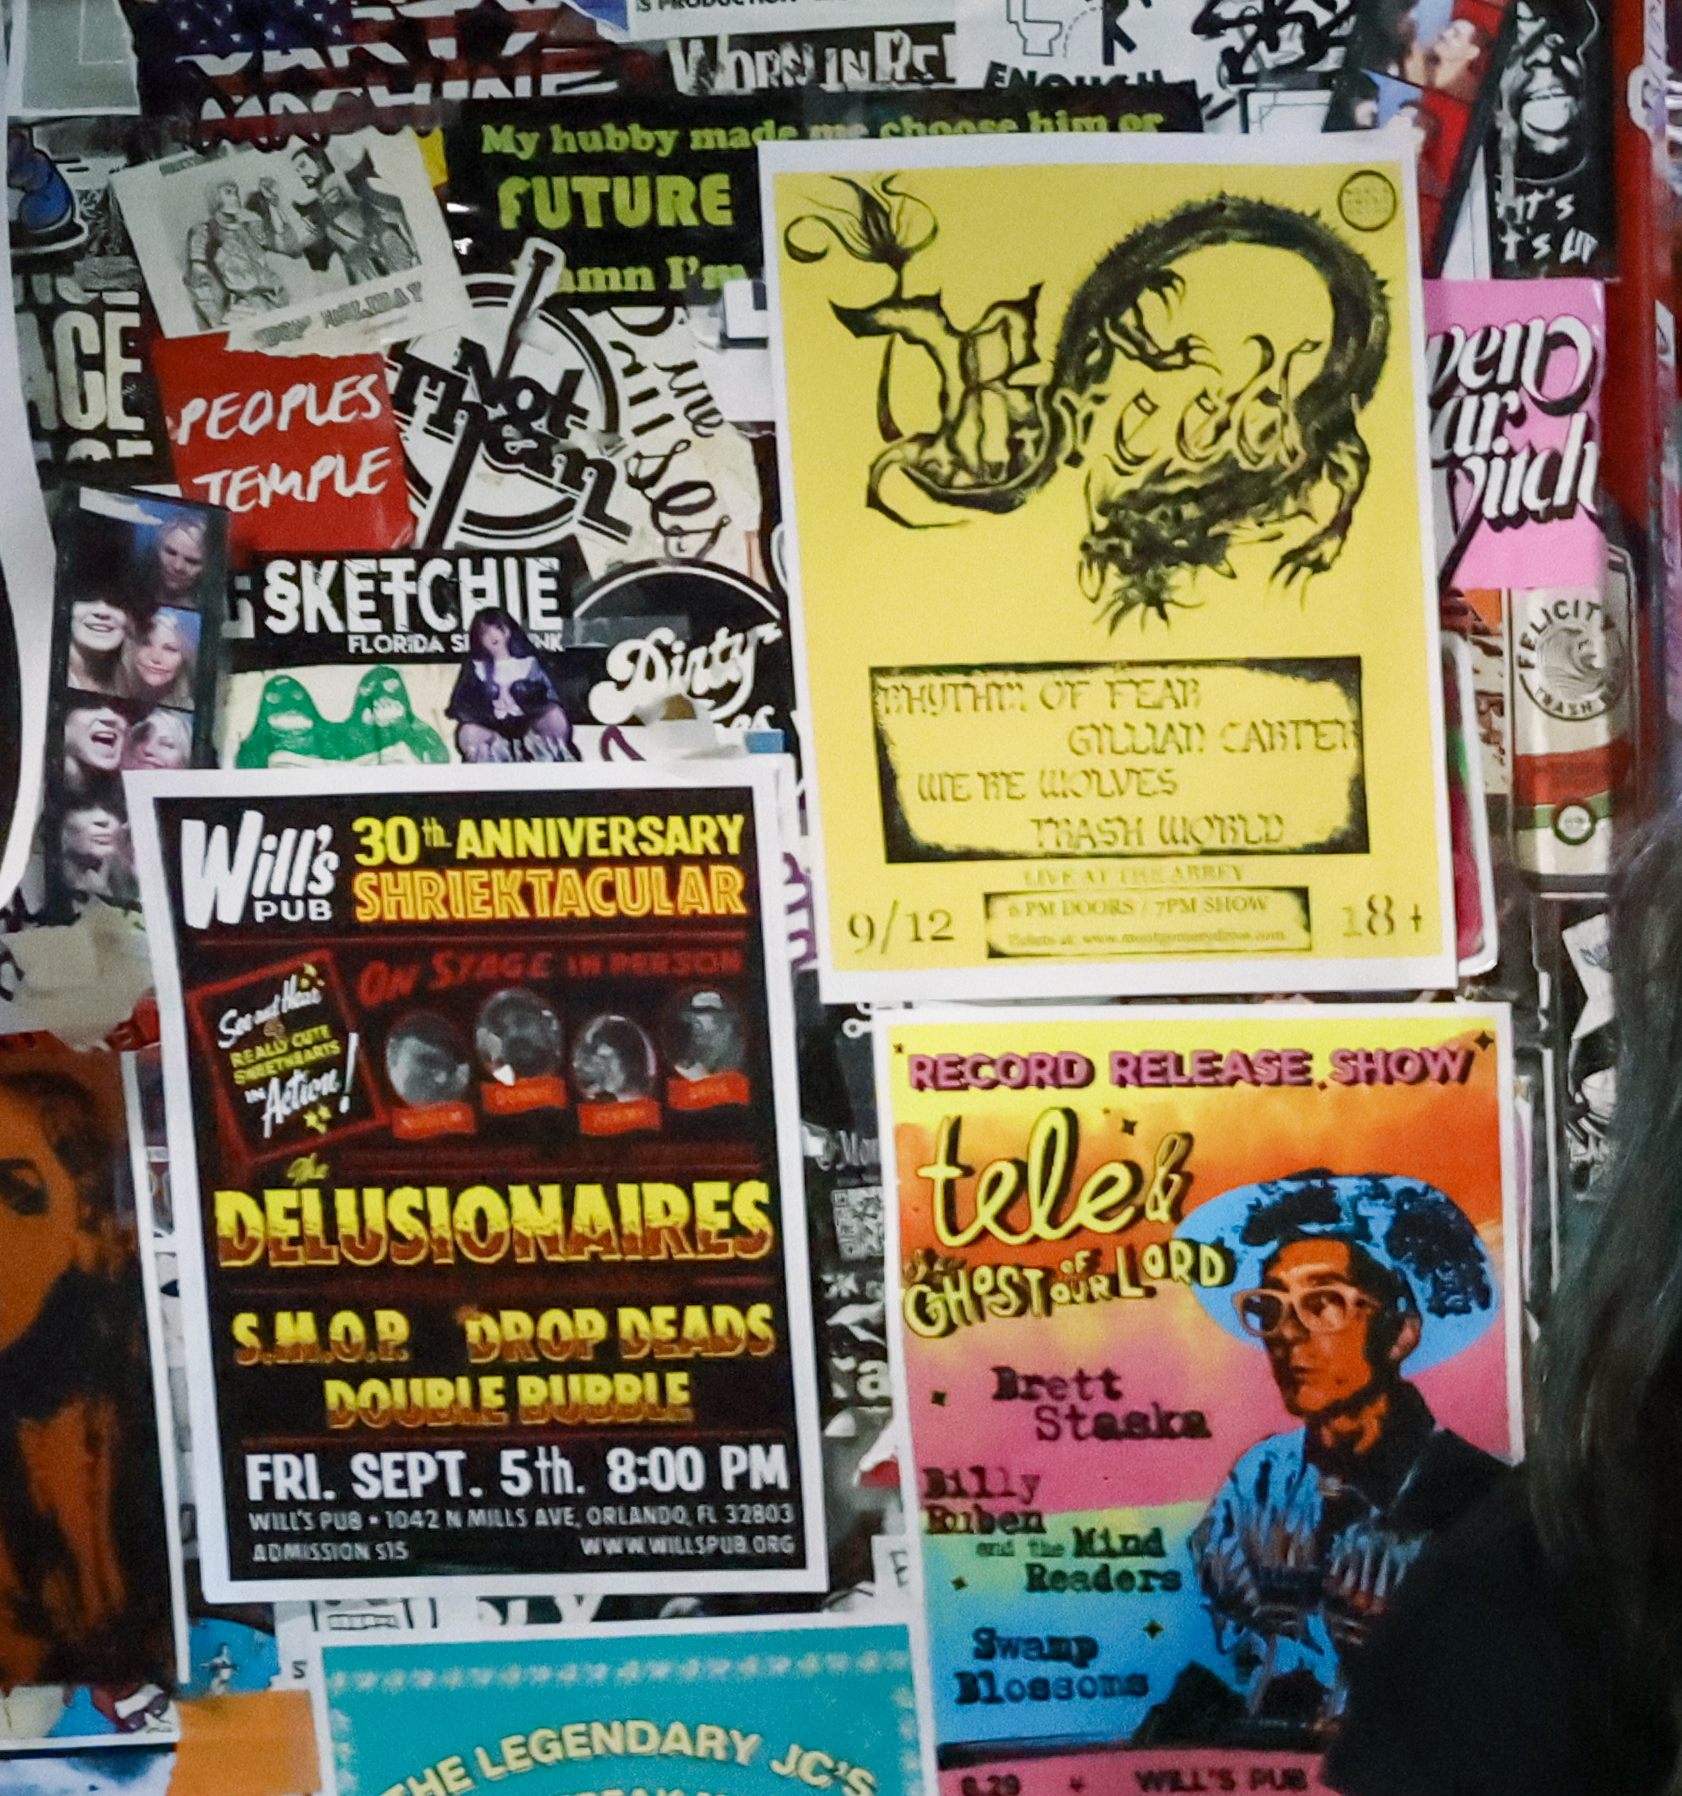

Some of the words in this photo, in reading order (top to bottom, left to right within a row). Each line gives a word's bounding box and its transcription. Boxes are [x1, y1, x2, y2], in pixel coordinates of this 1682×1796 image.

[481, 124, 541, 161] My
[552, 123, 680, 158] hubby
[689, 119, 798, 151] made
[498, 172, 733, 229] FUTURE
[174, 372, 384, 445] PEOPLES
[193, 447, 393, 513] TEMPLE
[264, 557, 564, 637] SKETCHIE
[347, 633, 442, 655] FLORIDA
[1039, 679, 1091, 711] OF
[456, 813, 745, 860] ANNIVERSARY
[1030, 816, 1144, 850] TRASH
[179, 808, 340, 930] Will's
[254, 899, 333, 922] PUB
[352, 864, 748, 924] SHRIEKTACULAR
[1062, 899, 1135, 917] DOORS
[1204, 894, 1269, 914] SHOW
[848, 900, 955, 954] 9/12
[907, 1050, 1098, 1092] RECORD
[1107, 1047, 1315, 1088] RELEASE
[1327, 1046, 1476, 1085] SHOW
[213, 1180, 776, 1268] DELUSIONAIRES
[1115, 1235, 1236, 1301] LORD
[463, 1307, 607, 1365] DROP
[616, 1303, 778, 1360] DEADS
[324, 1375, 511, 1431] DOUBLE
[518, 1370, 696, 1426] BUBBLE
[990, 1363, 1125, 1404] Brett
[244, 1451, 338, 1502] FRI.
[350, 1449, 485, 1501] SEPT.
[606, 1445, 705, 1492] 8:00
[720, 1443, 791, 1491] PM
[921, 1465, 1042, 1506] Billy
[249, 1509, 314, 1532] WILL'S
[319, 1509, 363, 1531] PUB
[385, 1507, 441, 1530] 1042
[446, 1508, 463, 1528] N
[467, 1507, 527, 1528] MILLS
[724, 1502, 796, 1526] 32803
[922, 1503, 1048, 1537] Ruben
[252, 1540, 373, 1563] ADMISSION
[1026, 1535, 1067, 1559] the
[1071, 1525, 1167, 1559] Mind
[1025, 1561, 1183, 1595] Readers
[971, 1625, 1100, 1669] Swamp
[953, 1669, 1150, 1706] Blossoms
[472, 1718, 762, 1782] LEGENDARY
[1133, 1765, 1239, 1795] WILL'S
[1249, 1766, 1311, 1794] PUB
